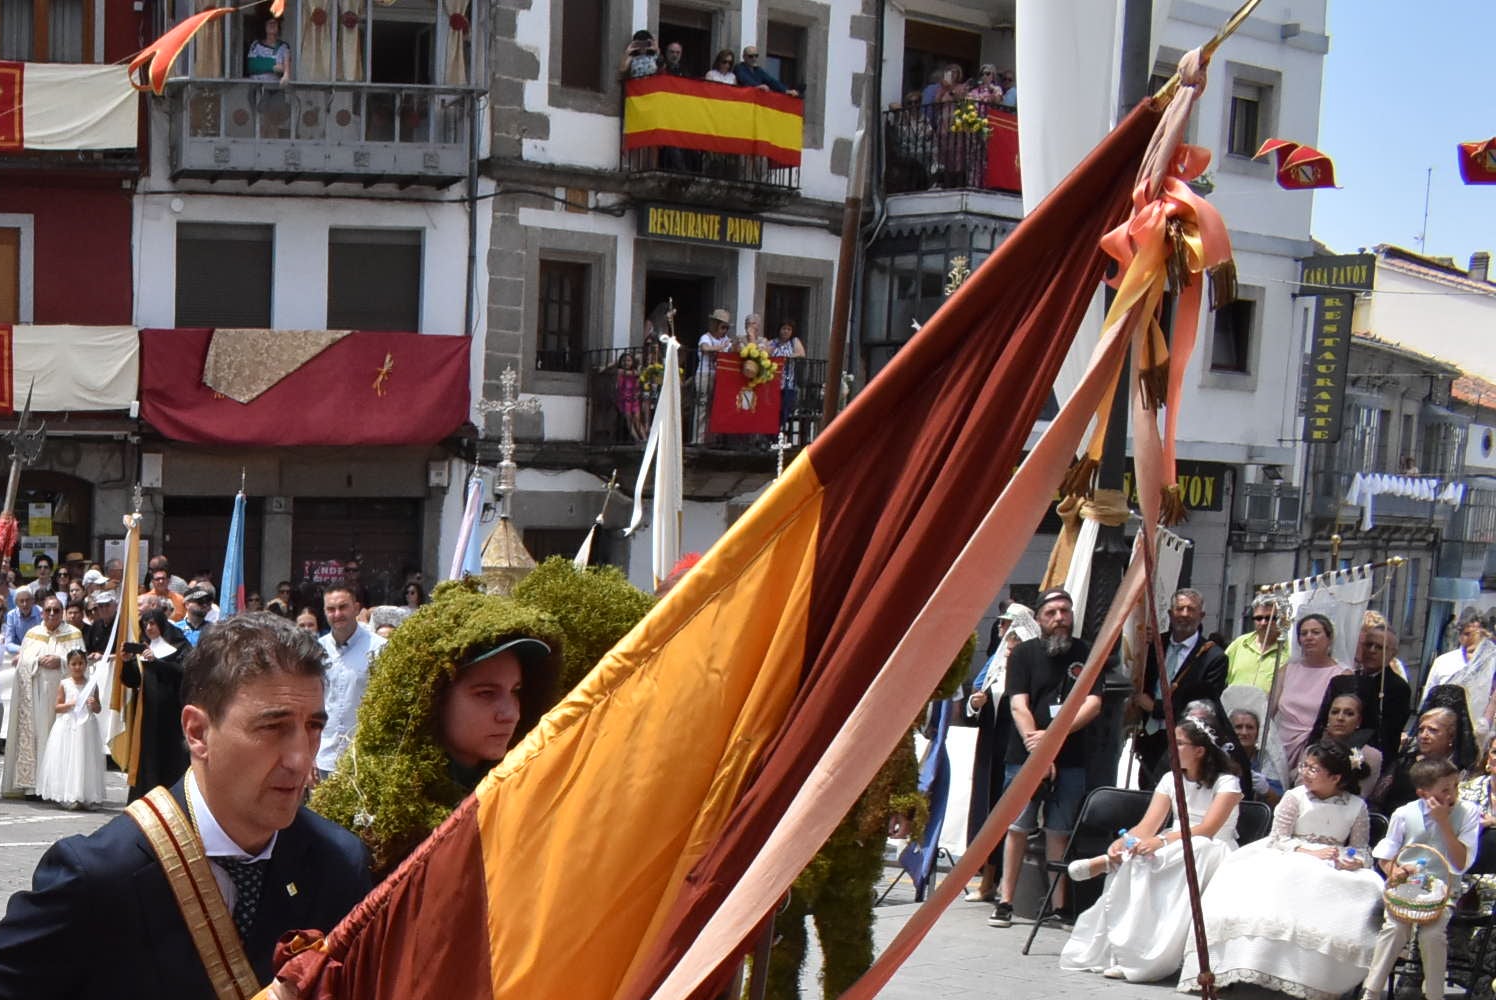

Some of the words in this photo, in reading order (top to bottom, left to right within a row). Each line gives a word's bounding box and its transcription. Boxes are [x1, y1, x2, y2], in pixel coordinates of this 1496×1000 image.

[648, 207, 721, 241] RESTAURANTE
[726, 217, 761, 244] PAVON
[1309, 297, 1344, 440] RESTAURANTE
[1178, 475, 1216, 507] VON
